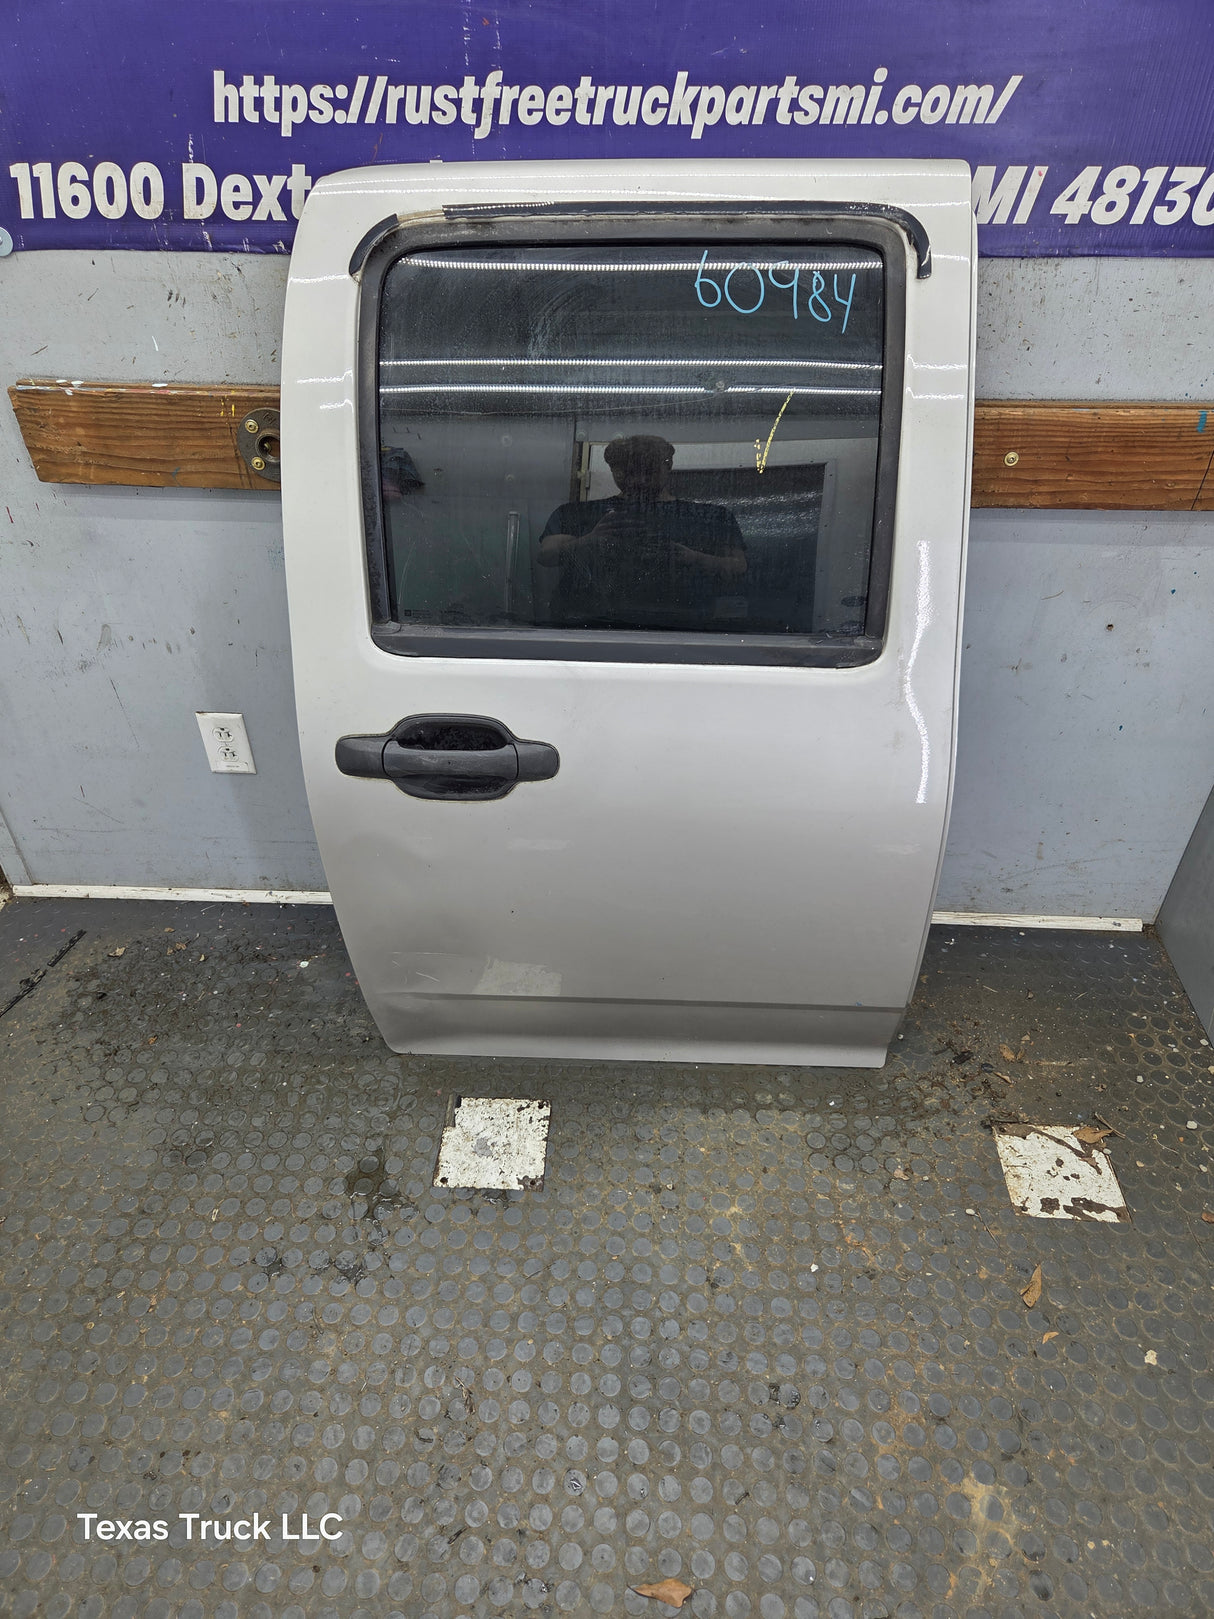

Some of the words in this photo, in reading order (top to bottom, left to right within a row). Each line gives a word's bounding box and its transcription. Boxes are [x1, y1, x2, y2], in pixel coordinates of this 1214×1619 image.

[213, 68, 1023, 140] https://rustfreetruckpartsmi.com/
[9, 161, 165, 220] 11600
[971, 165, 1049, 224] MI
[695, 249, 857, 334] 60984
